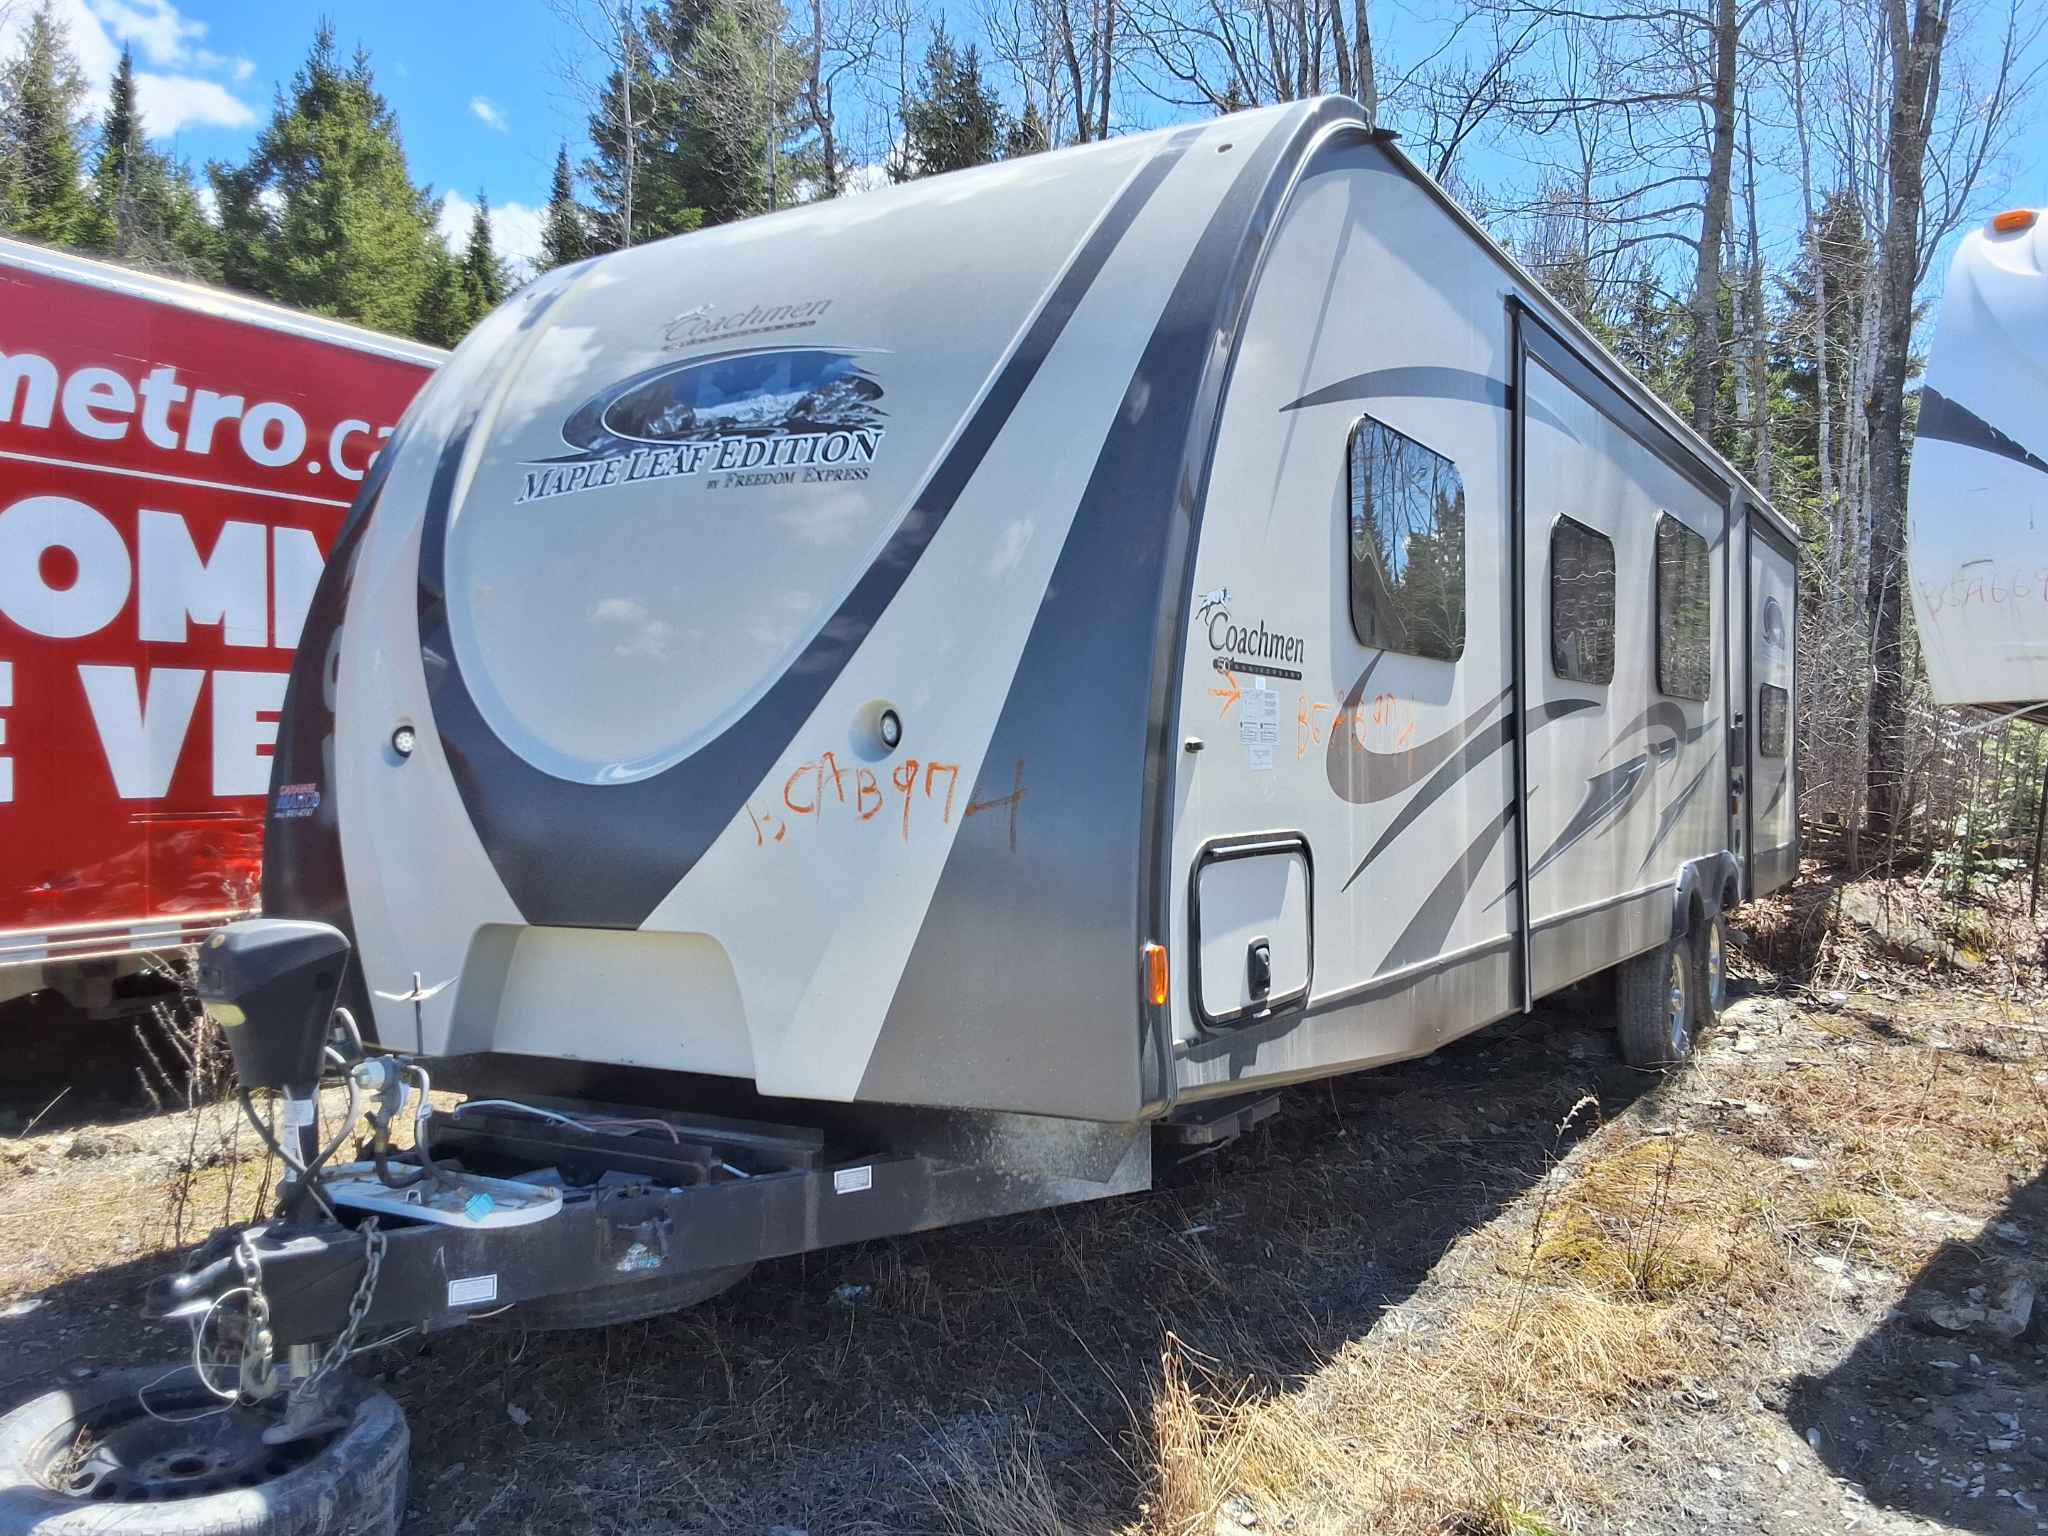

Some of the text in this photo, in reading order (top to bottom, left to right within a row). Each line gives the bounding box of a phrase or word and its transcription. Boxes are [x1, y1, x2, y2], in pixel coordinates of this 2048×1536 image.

[664, 300, 833, 342] Coachmen
[517, 431, 881, 503] MAPLE LEAF EDITION
[724, 470, 796, 489] FREEDOM
[800, 466, 870, 484] EXPRESS
[1208, 611, 1304, 663] Coachmen
